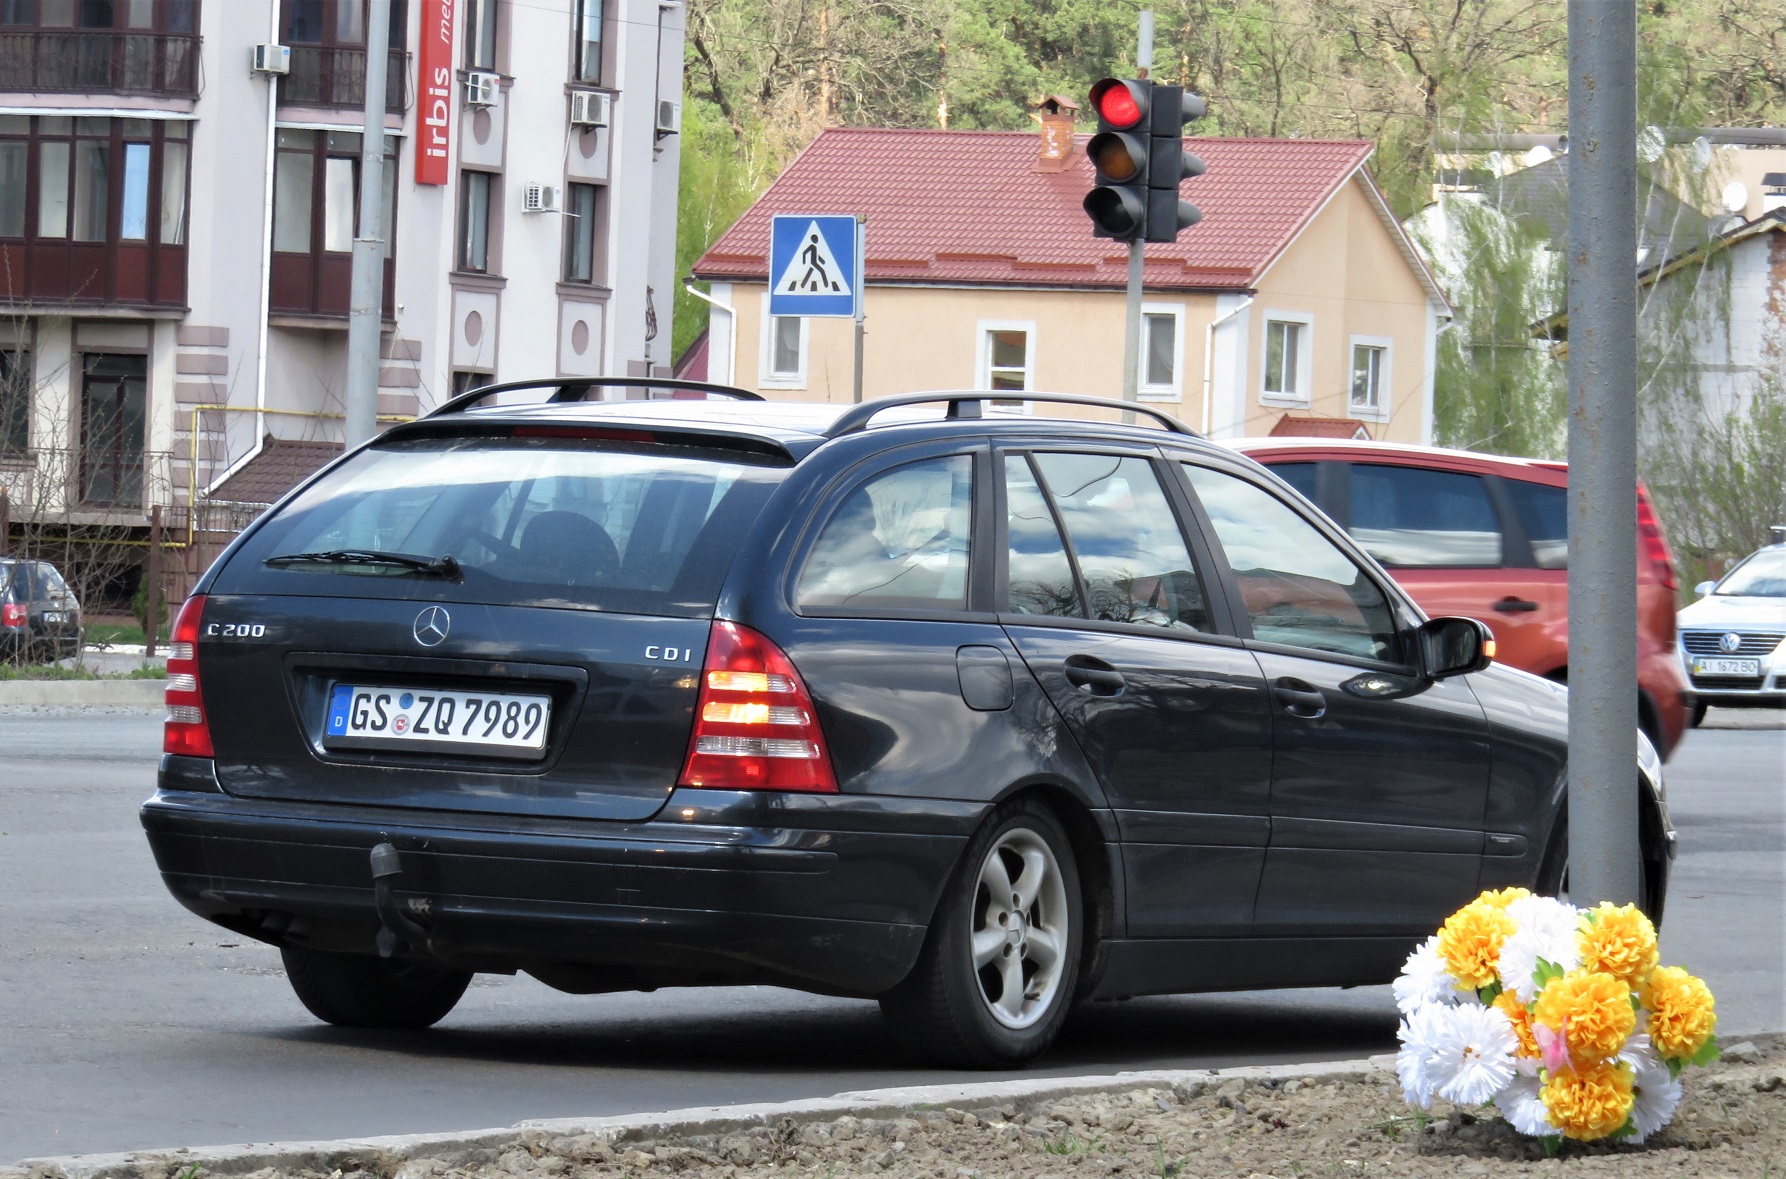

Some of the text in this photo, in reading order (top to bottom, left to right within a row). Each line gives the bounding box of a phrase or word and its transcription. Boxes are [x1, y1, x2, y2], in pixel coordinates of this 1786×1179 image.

[425, 67, 450, 158] irbis
[645, 645, 691, 662] CDI
[334, 715, 343, 727] D
[351, 693, 543, 740] GS ZQ 7989
